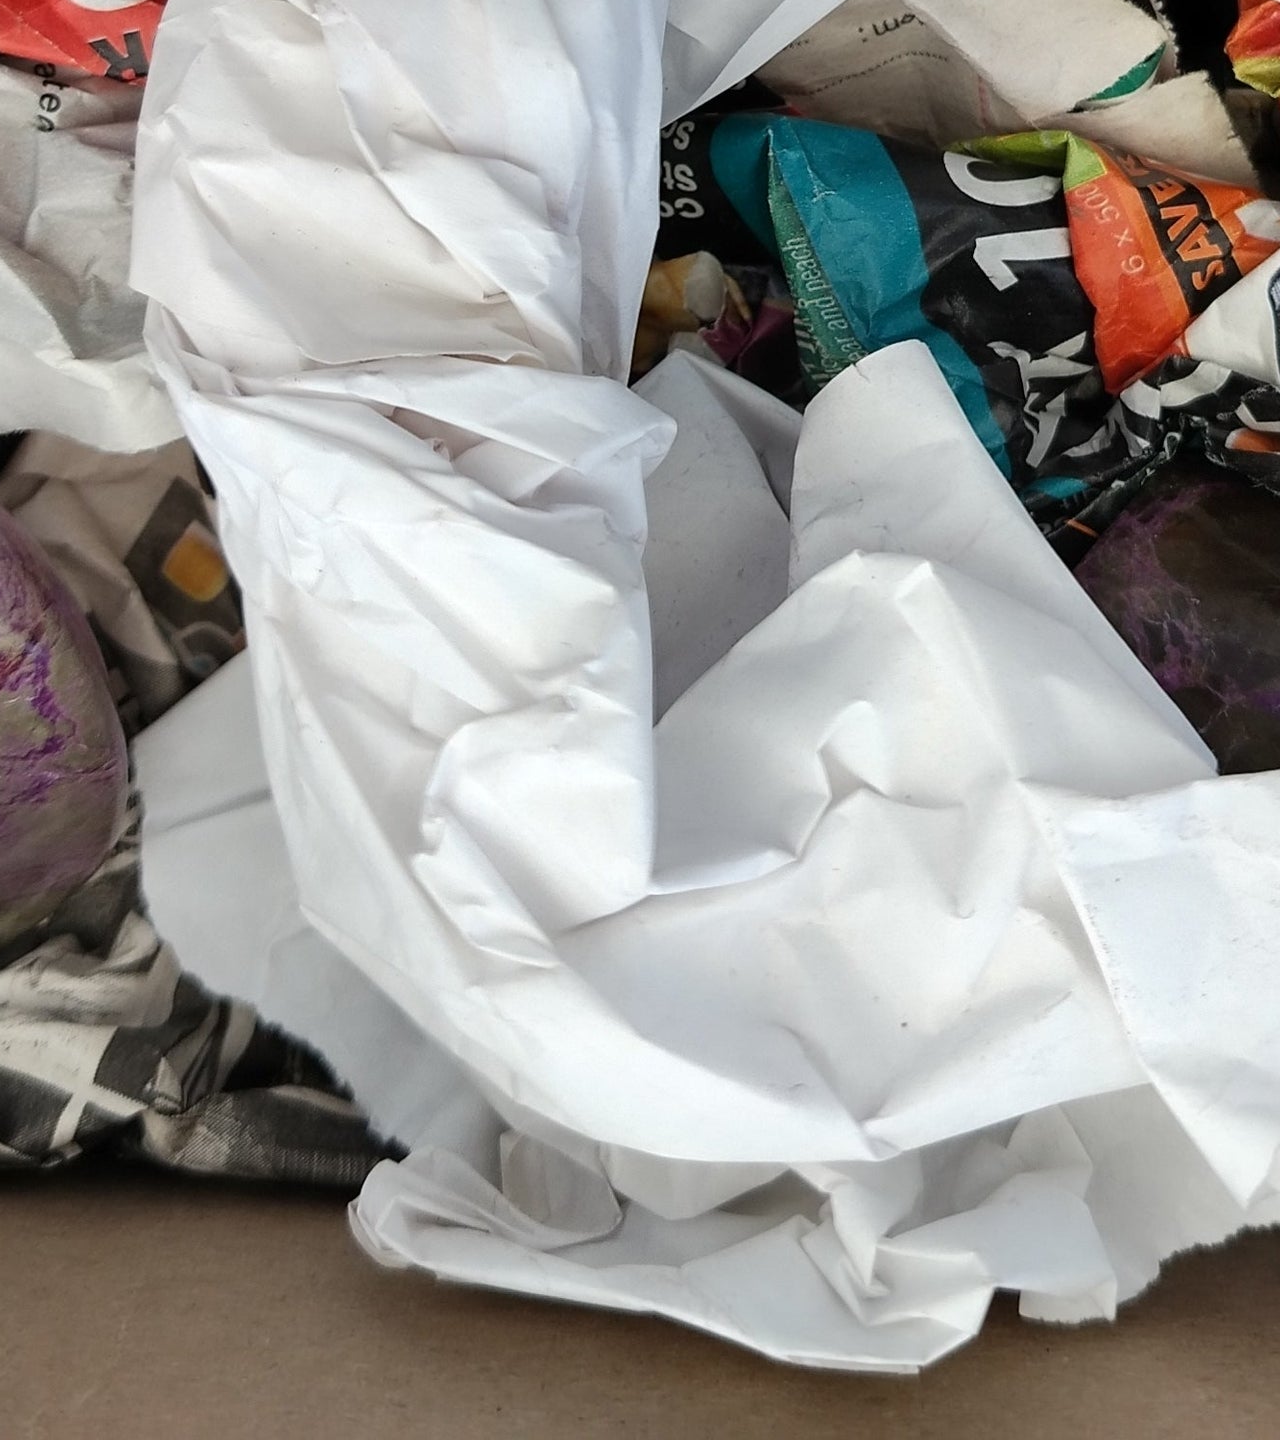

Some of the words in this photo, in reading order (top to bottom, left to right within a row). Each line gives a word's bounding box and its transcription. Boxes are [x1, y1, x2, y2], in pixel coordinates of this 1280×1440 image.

[1151, 179, 1225, 291] SAVE
[787, 238, 824, 300] peach
[813, 298, 838, 336] and
